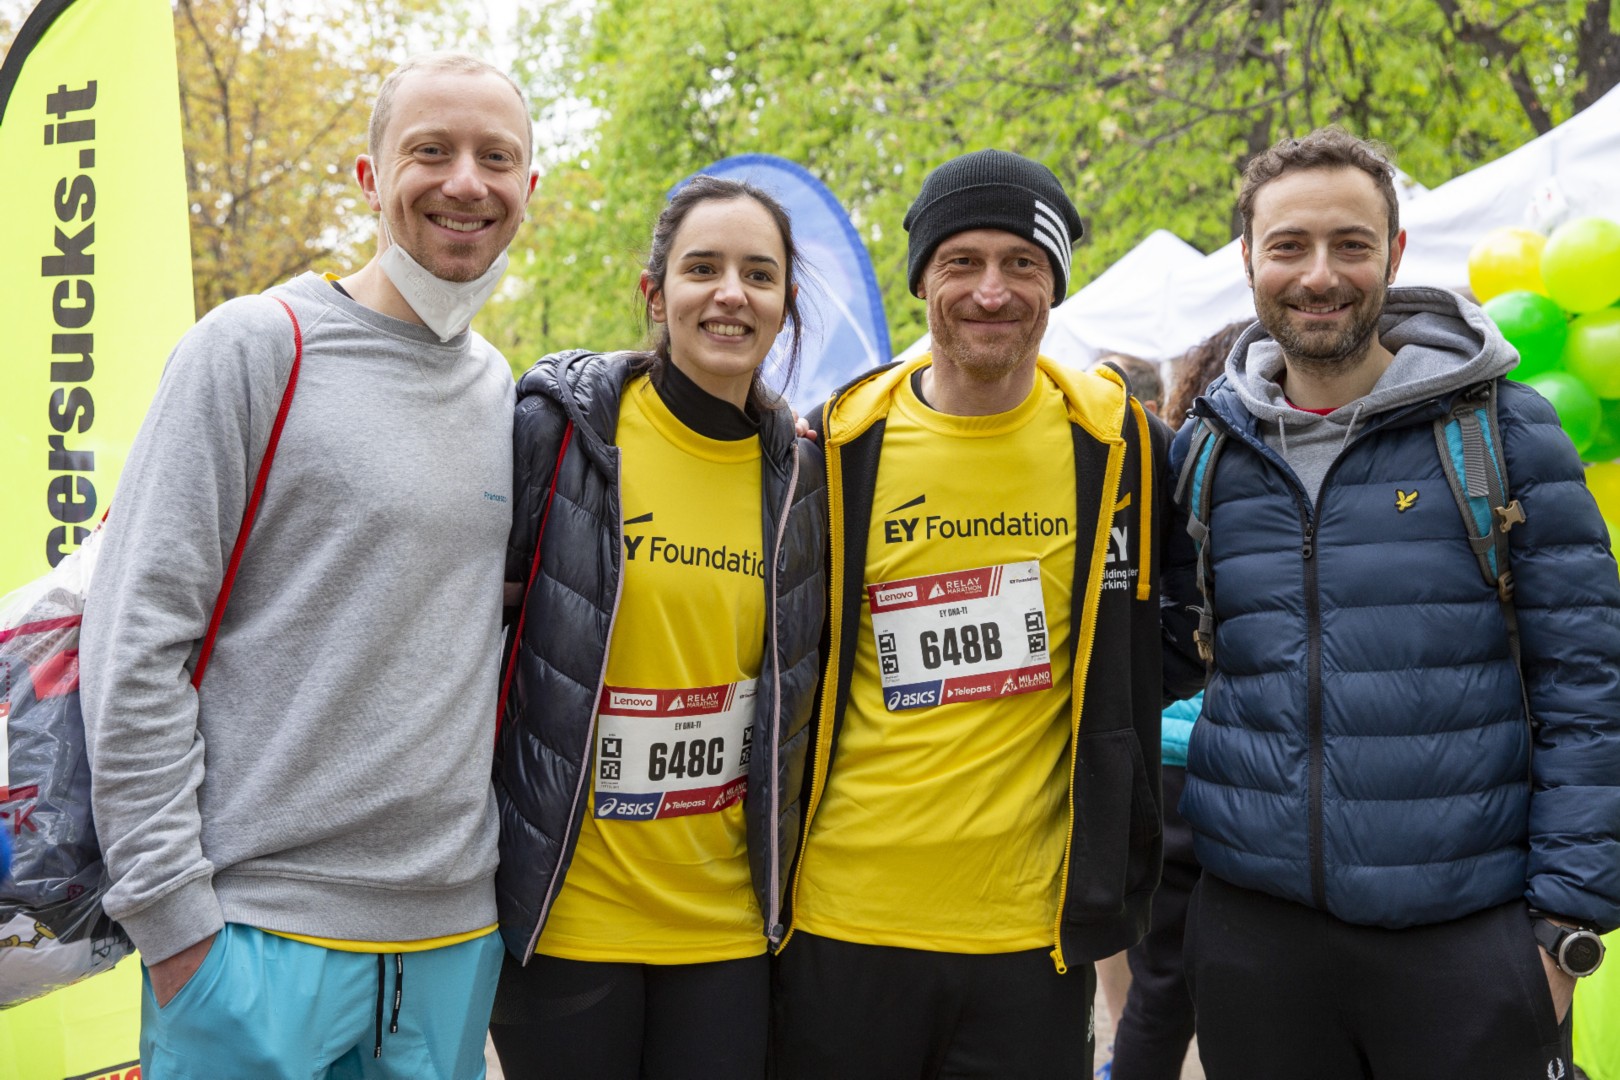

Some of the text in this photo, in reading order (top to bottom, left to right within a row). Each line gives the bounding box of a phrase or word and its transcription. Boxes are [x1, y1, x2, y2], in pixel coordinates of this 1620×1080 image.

[41, 80, 98, 568] cersucks.it
[884, 512, 1069, 544] EY Foundation
[623, 535, 765, 580] Y Foundati
[946, 577, 980, 588] RELAY
[947, 585, 982, 594] MARATHON
[879, 590, 914, 603] Lenovo
[920, 622, 1003, 670] 648B
[1018, 671, 1050, 684] MILANO
[687, 692, 719, 702] RELAY
[954, 685, 992, 697] Telepass
[614, 695, 653, 707] Lenovo
[687, 700, 719, 708] MARATHON
[648, 737, 725, 781] 648C
[672, 799, 706, 810] Telepass
